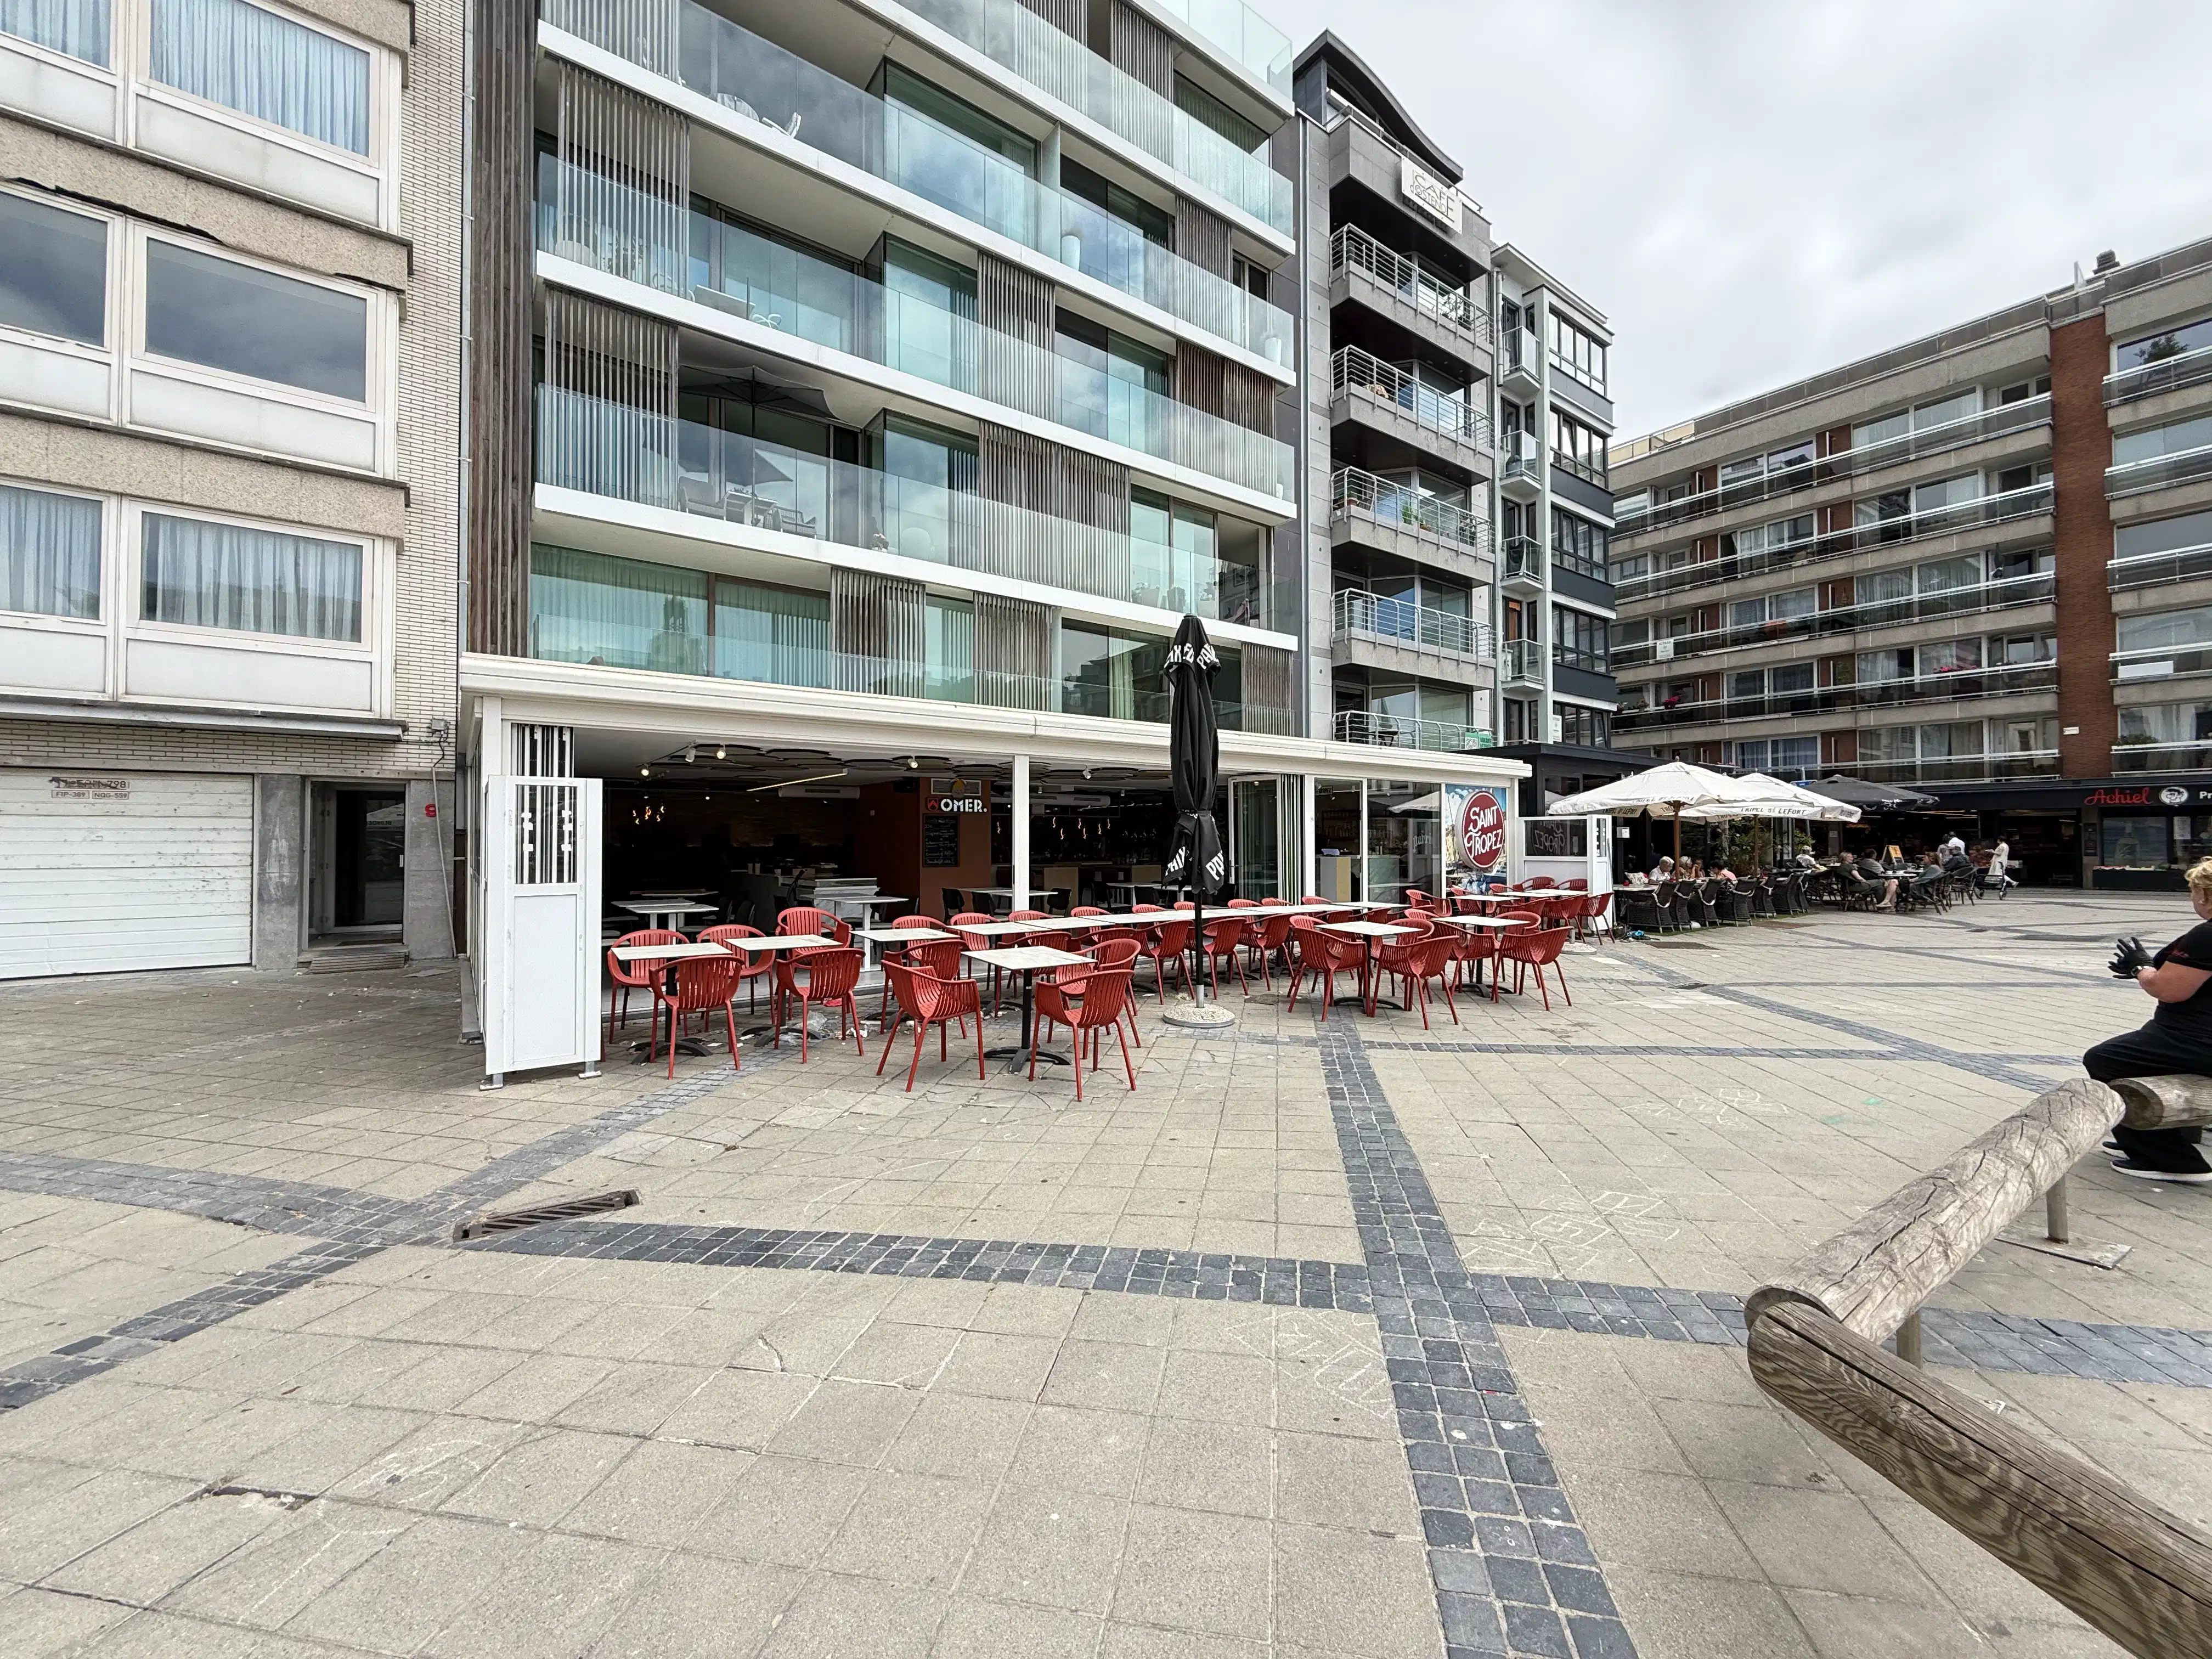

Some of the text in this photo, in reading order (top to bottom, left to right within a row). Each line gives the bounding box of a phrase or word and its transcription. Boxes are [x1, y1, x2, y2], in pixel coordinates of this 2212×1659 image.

[940, 798, 988, 812] OMER.
[2084, 786, 2154, 805] Achiel
[1468, 805, 1498, 833] SAINT
[1465, 829, 1503, 859] TROPEZ
